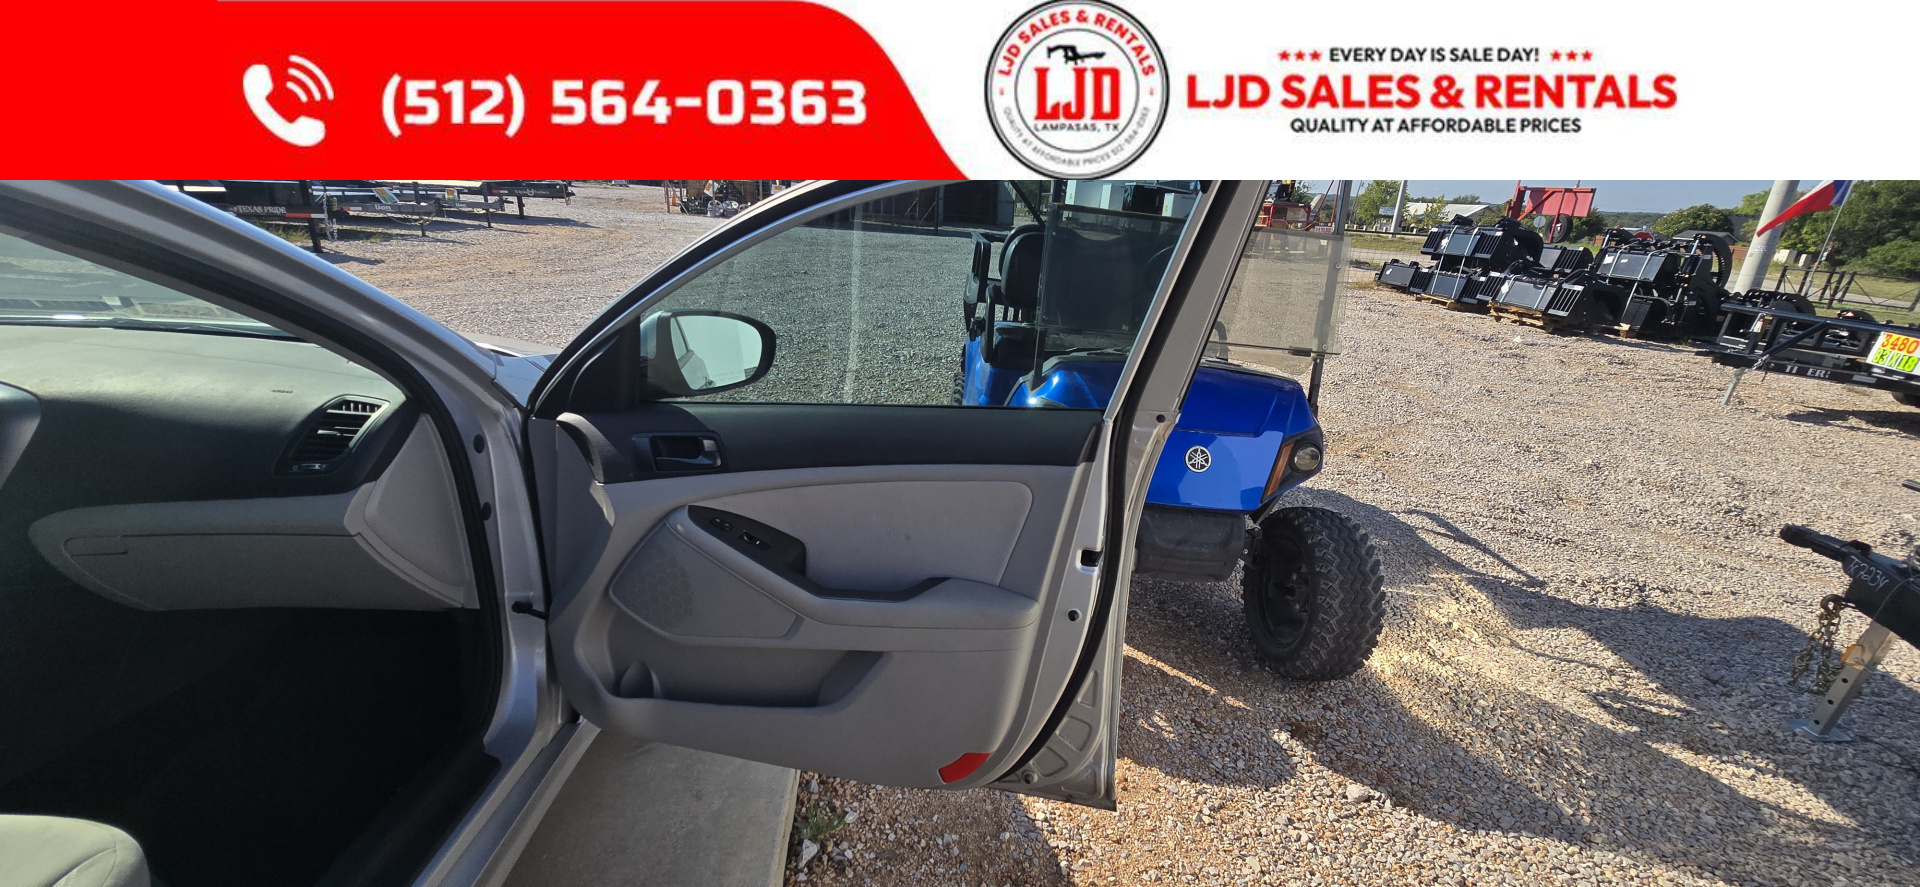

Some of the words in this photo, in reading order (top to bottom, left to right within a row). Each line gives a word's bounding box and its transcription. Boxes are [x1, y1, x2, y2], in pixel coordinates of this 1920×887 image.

[236, 205, 263, 214] TEXAS
[263, 205, 287, 214] PRIDE
[1881, 333, 1920, 354] 3480
